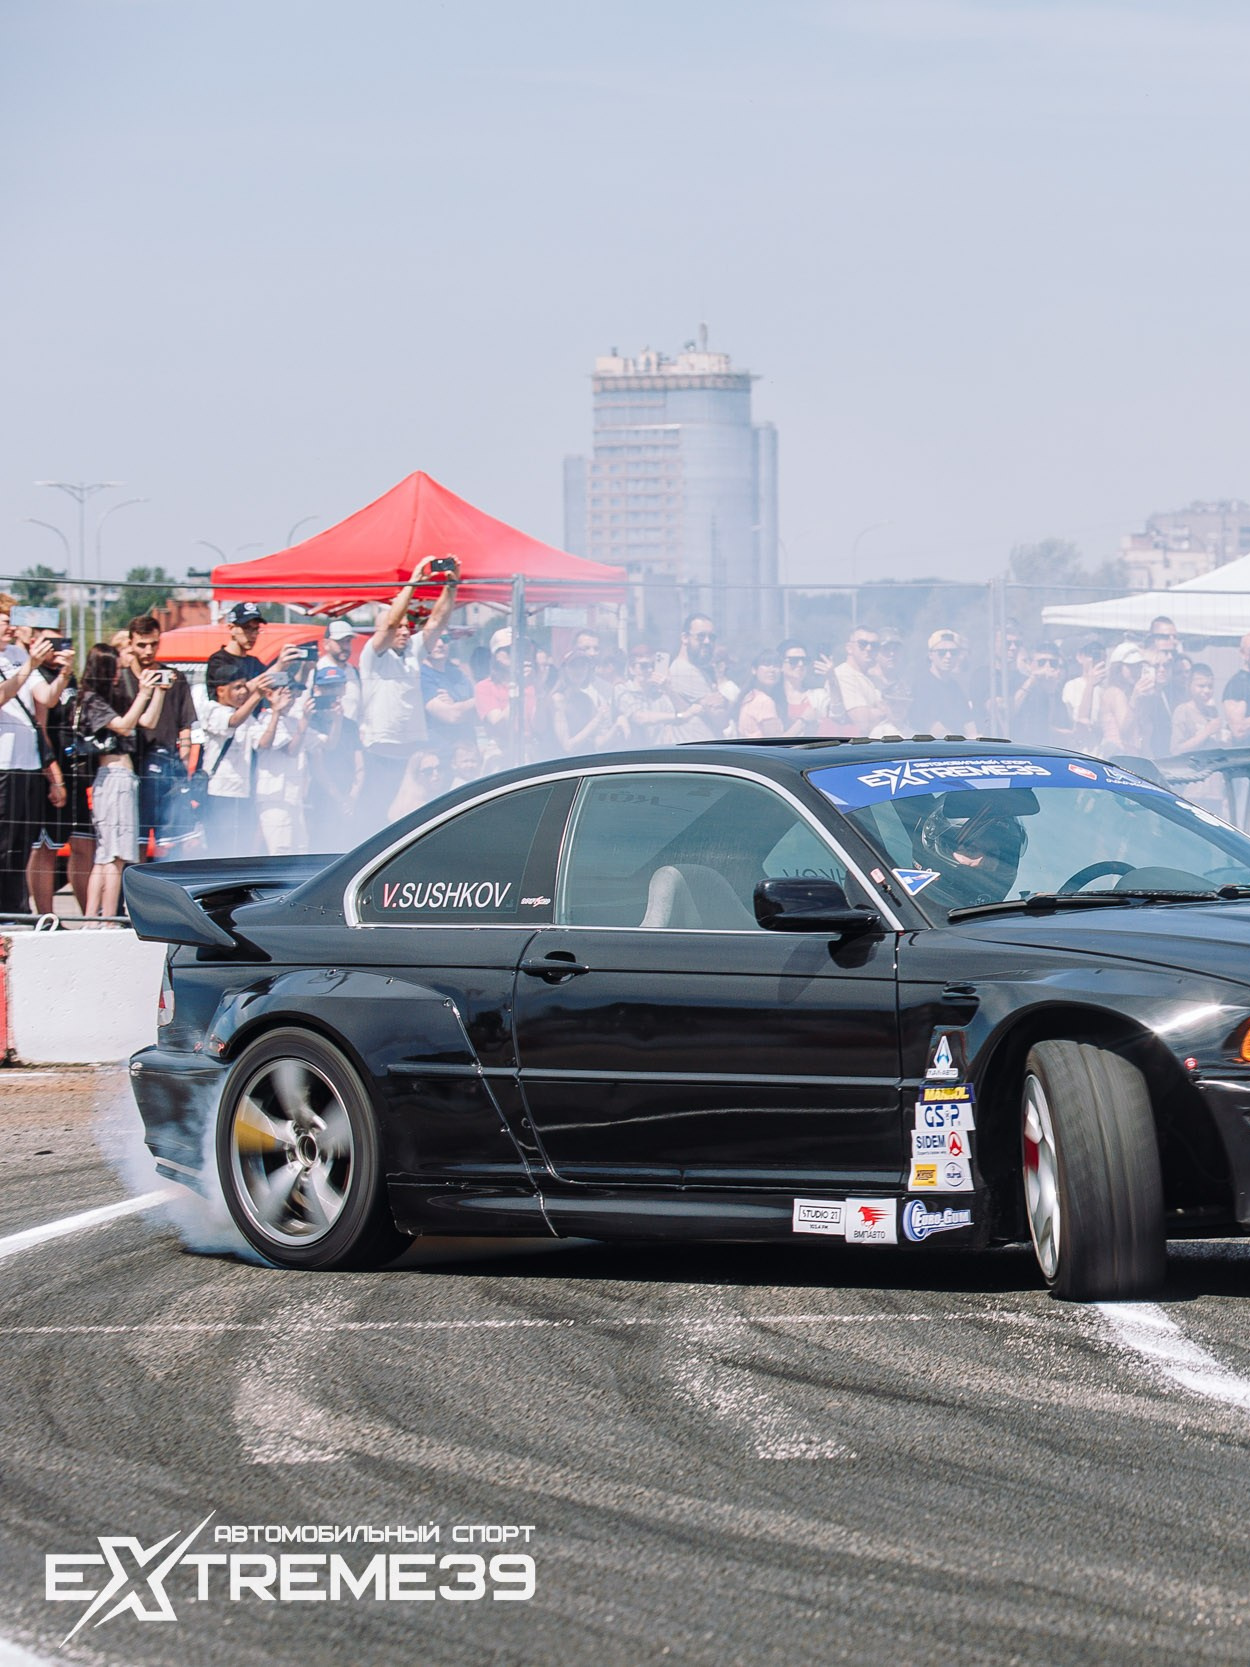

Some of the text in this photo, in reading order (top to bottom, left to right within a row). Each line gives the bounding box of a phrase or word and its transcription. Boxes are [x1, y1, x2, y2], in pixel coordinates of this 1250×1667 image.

[857, 761, 1051, 795] EXTREME39
[383, 882, 512, 908] V.SUSHKOV
[916, 1135, 946, 1149] SIDEM
[802, 1210, 838, 1219] STUDIO 21
[854, 1230, 885, 1239] ВМПАВТО
